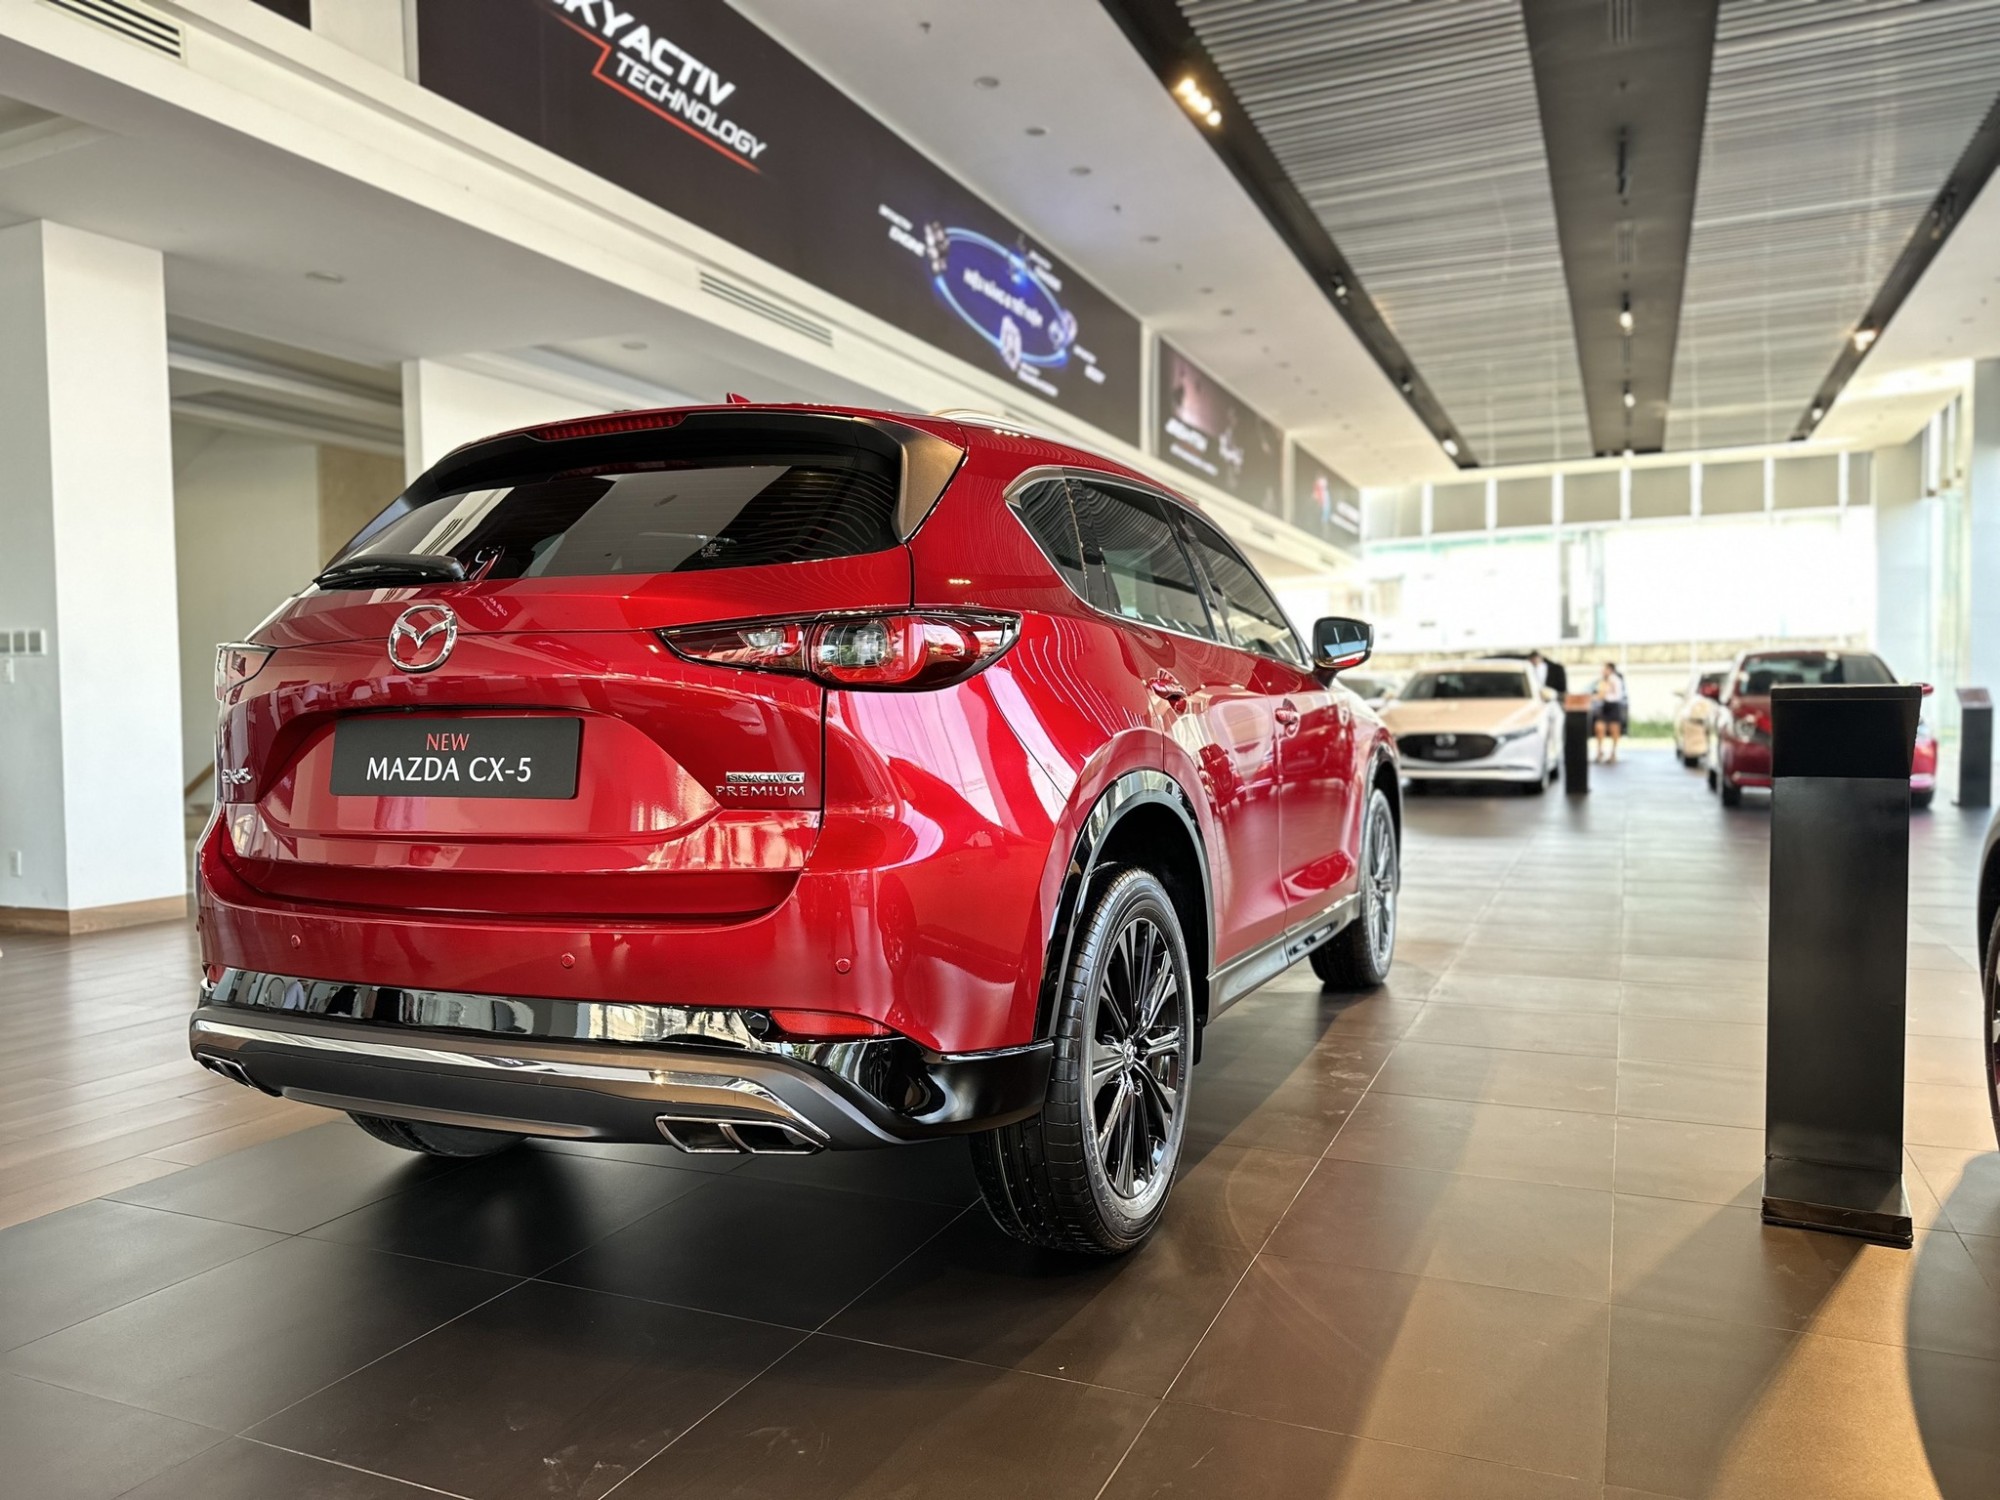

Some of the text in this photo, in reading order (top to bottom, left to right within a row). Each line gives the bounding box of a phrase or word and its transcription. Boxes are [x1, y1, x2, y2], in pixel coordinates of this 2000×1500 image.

[553, 0, 736, 106] KYACTIV
[615, 52, 768, 159] TECHNOLOGY
[426, 733, 470, 751] NEW
[366, 757, 532, 782] MAZDA CX-5
[715, 785, 806, 797] PREMIUM
